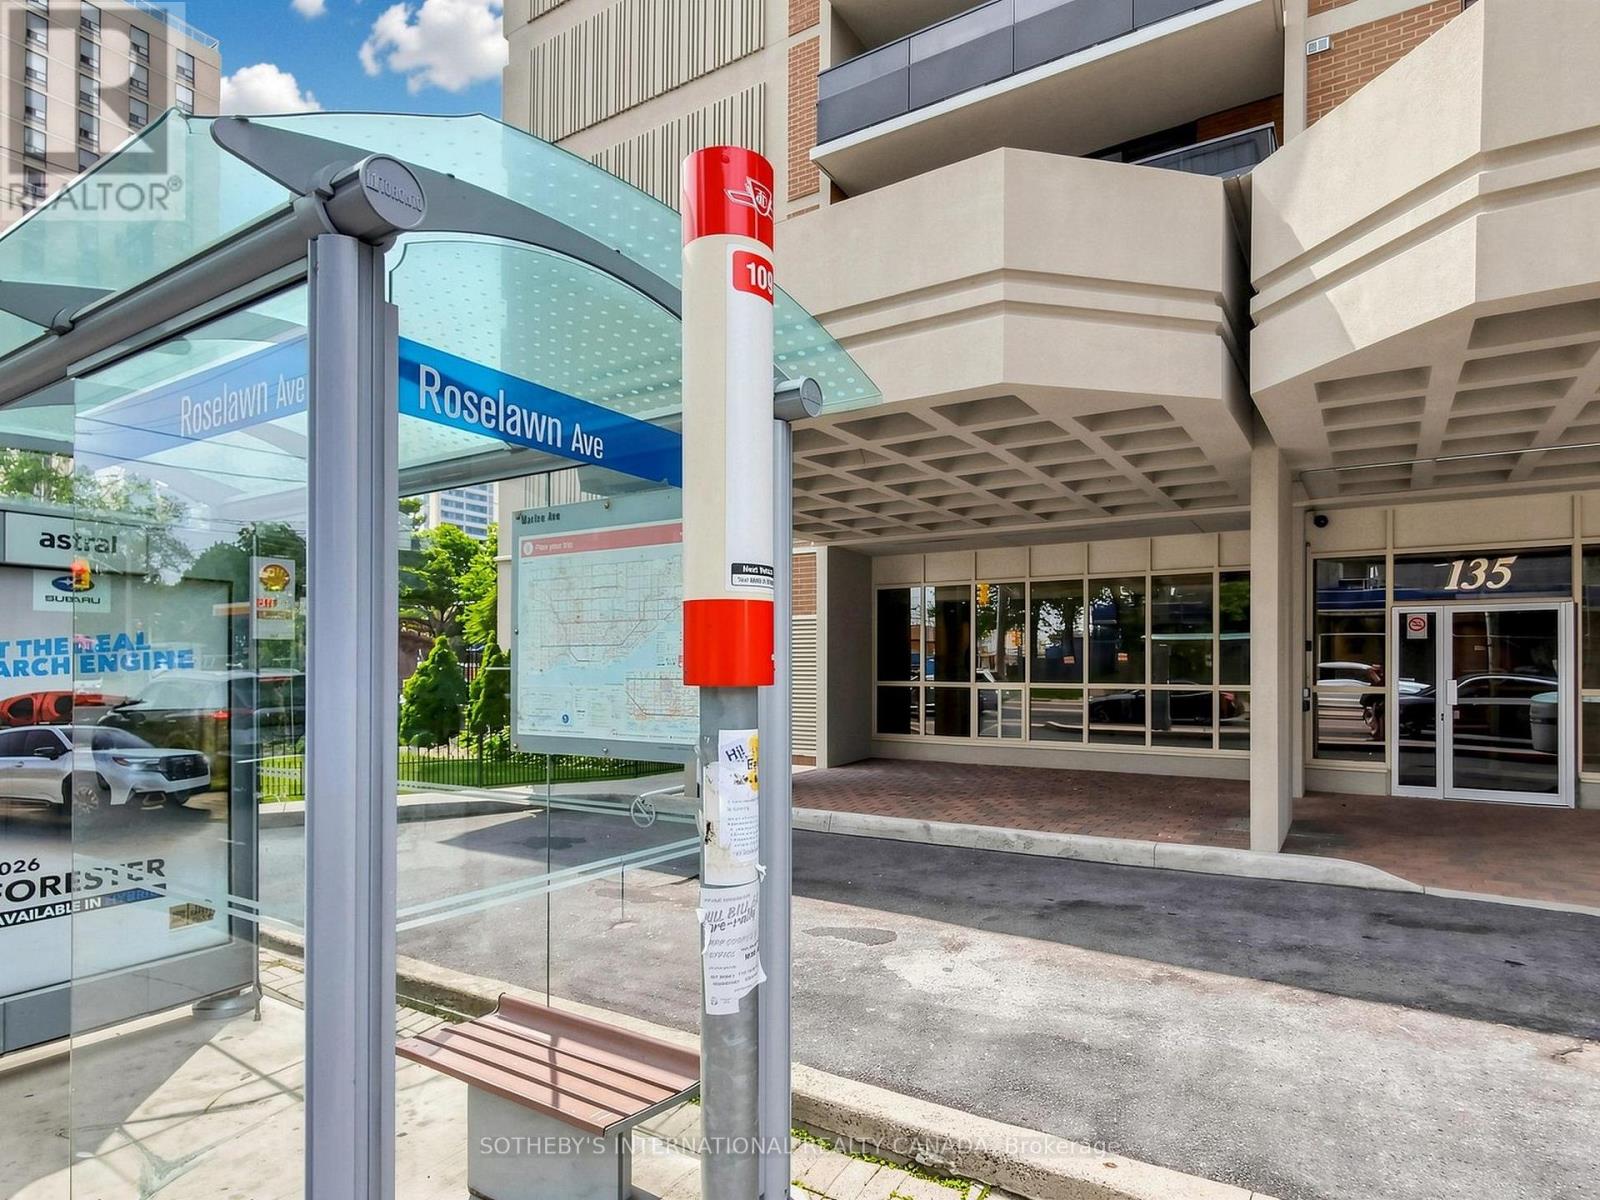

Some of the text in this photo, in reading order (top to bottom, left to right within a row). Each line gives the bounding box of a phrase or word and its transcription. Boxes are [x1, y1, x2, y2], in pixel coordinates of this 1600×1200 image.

[180, 374, 305, 437] Roselawn Ave
[419, 364, 604, 459] Roselawn Ave
[39, 532, 117, 553] astral
[1444, 555, 1518, 591] 135
[45, 595, 100, 604] SUBARU
[16, 637, 68, 657] THE
[80, 649, 194, 674] ENGINE
[725, 744, 745, 762] Hi!
[0, 858, 165, 903] ORESTER
[84, 897, 102, 910] IN
